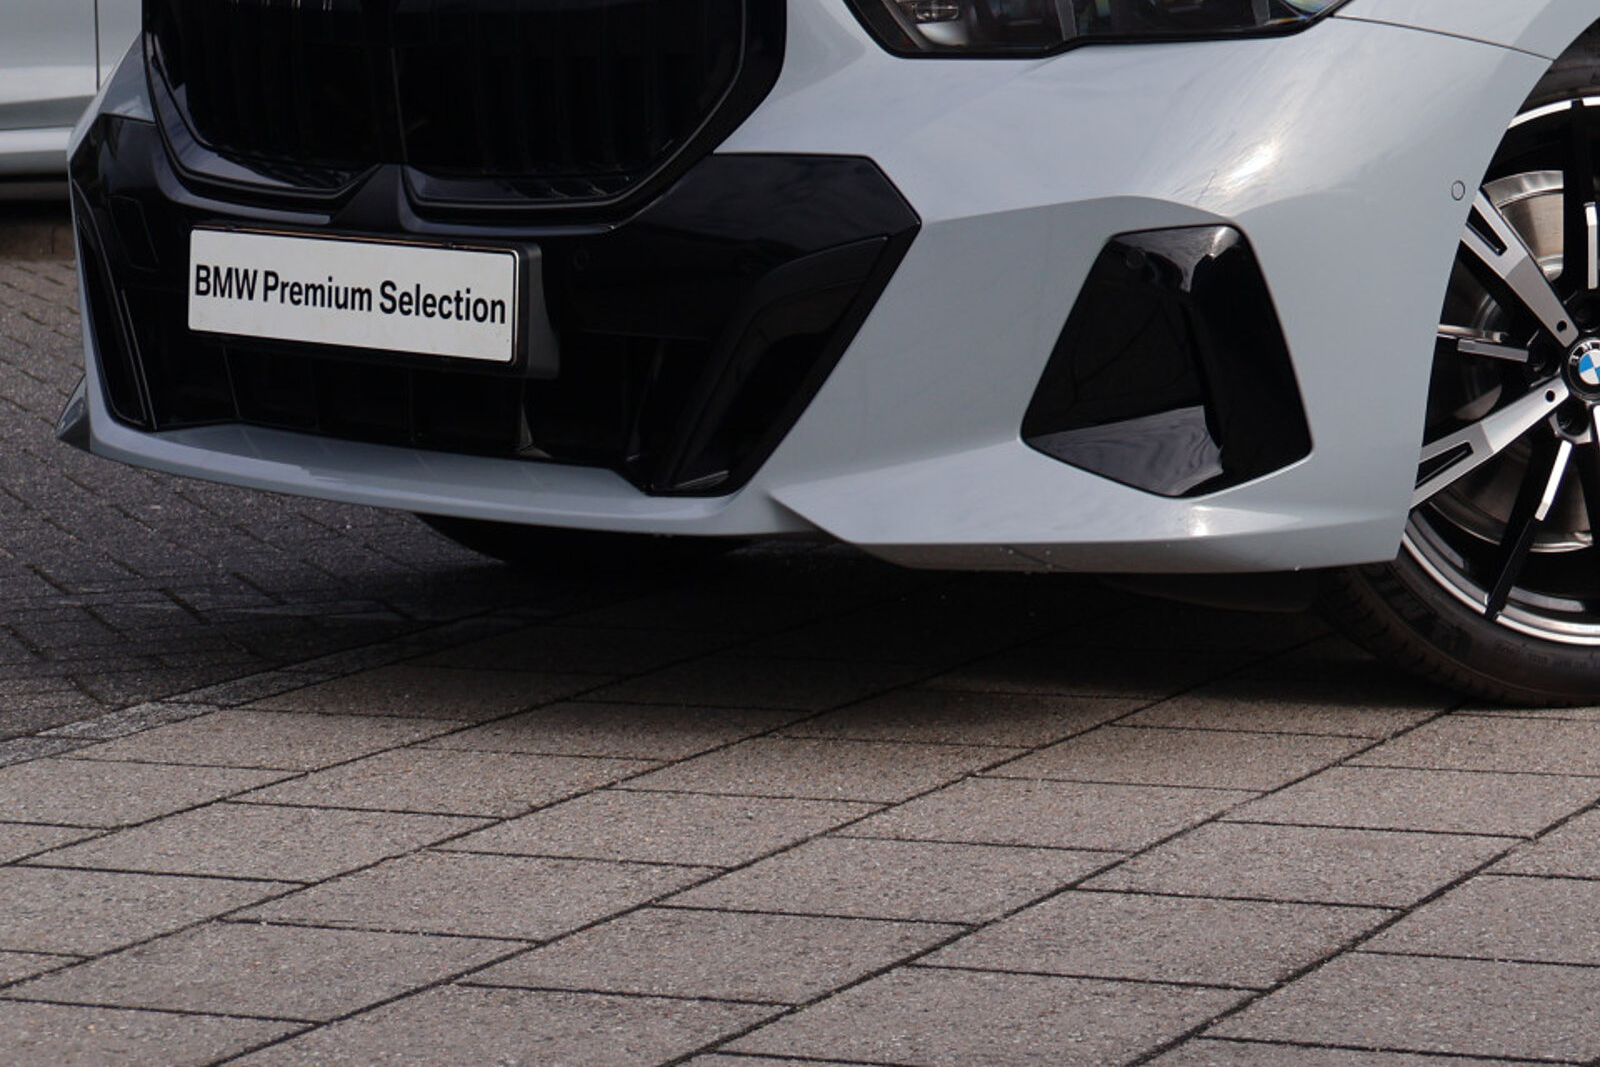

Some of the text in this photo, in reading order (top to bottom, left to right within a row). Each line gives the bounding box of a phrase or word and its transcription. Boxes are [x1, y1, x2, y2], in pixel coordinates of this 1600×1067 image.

[195, 264, 506, 324] BMW Premium Selection
